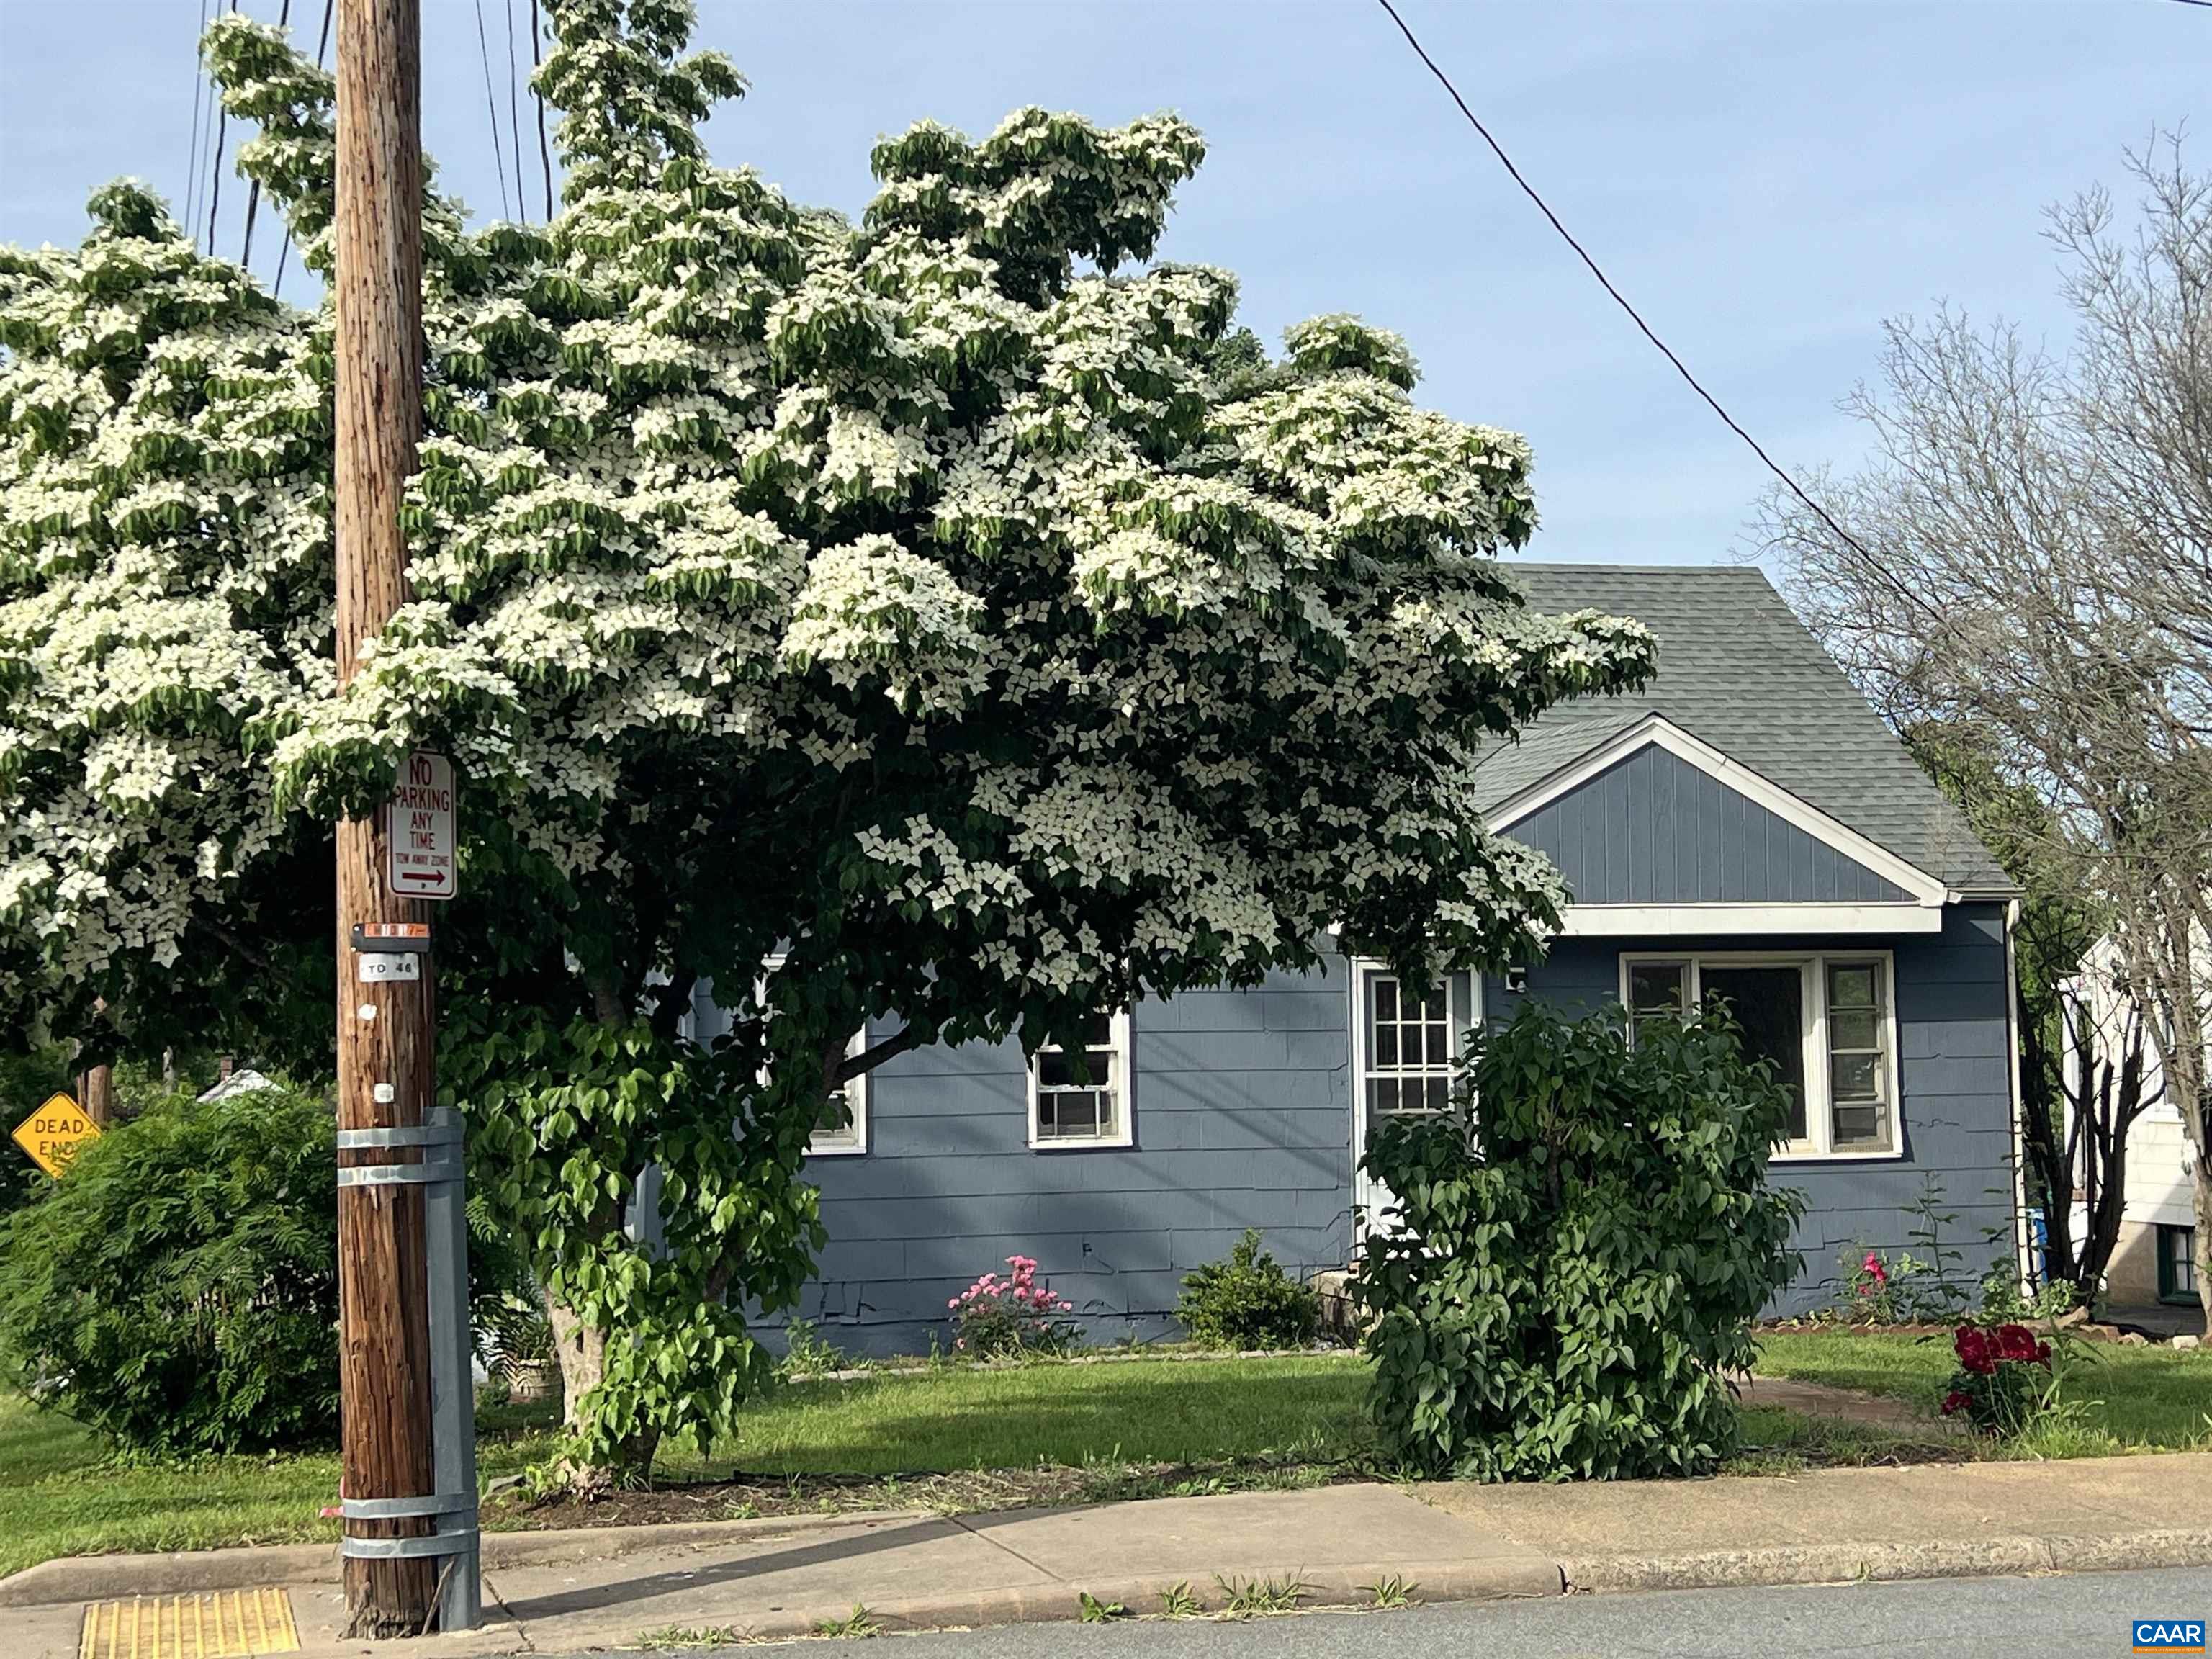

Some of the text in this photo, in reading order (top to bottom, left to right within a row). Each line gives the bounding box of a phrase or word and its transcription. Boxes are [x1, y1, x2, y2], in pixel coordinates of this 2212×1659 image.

[409, 758, 432, 786] NO
[392, 786, 450, 812] PARKING
[410, 811, 433, 830] ANY
[410, 831, 436, 850] TIME
[395, 852, 409, 864] TOW
[431, 855, 449, 867] ZONE
[369, 963, 412, 974] TD 46
[35, 1119, 84, 1134] DEAD
